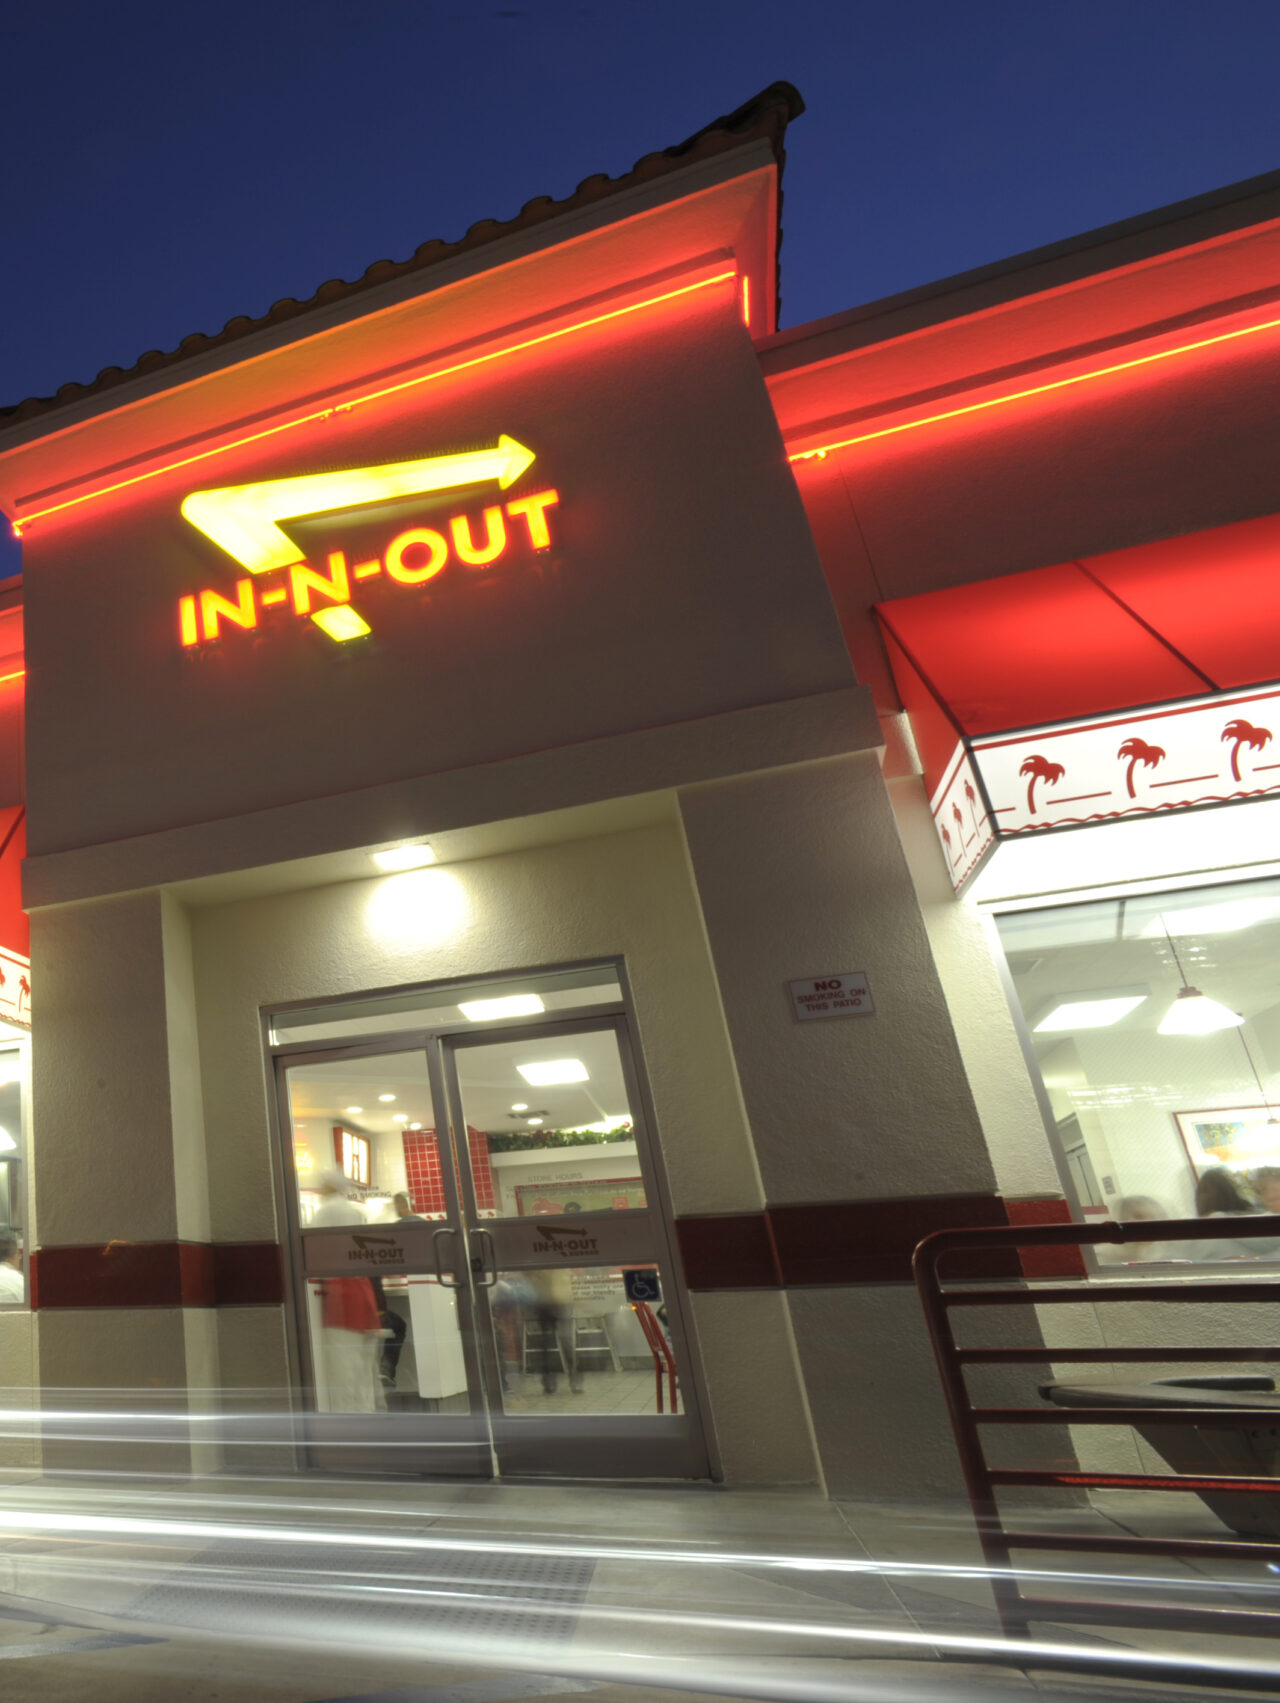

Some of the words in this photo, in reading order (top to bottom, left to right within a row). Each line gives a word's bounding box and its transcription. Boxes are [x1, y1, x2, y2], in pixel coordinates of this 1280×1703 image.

[179, 488, 560, 647] IN-N-OUT
[813, 979, 842, 992] NO
[797, 990, 846, 1004] SMOKING
[849, 988, 866, 997] ON
[805, 1001, 829, 1012] THIS
[832, 998, 862, 1009] PATIO
[532, 1238, 598, 1253] IN-N-OUT
[348, 1247, 404, 1261] IN-N-OUT
